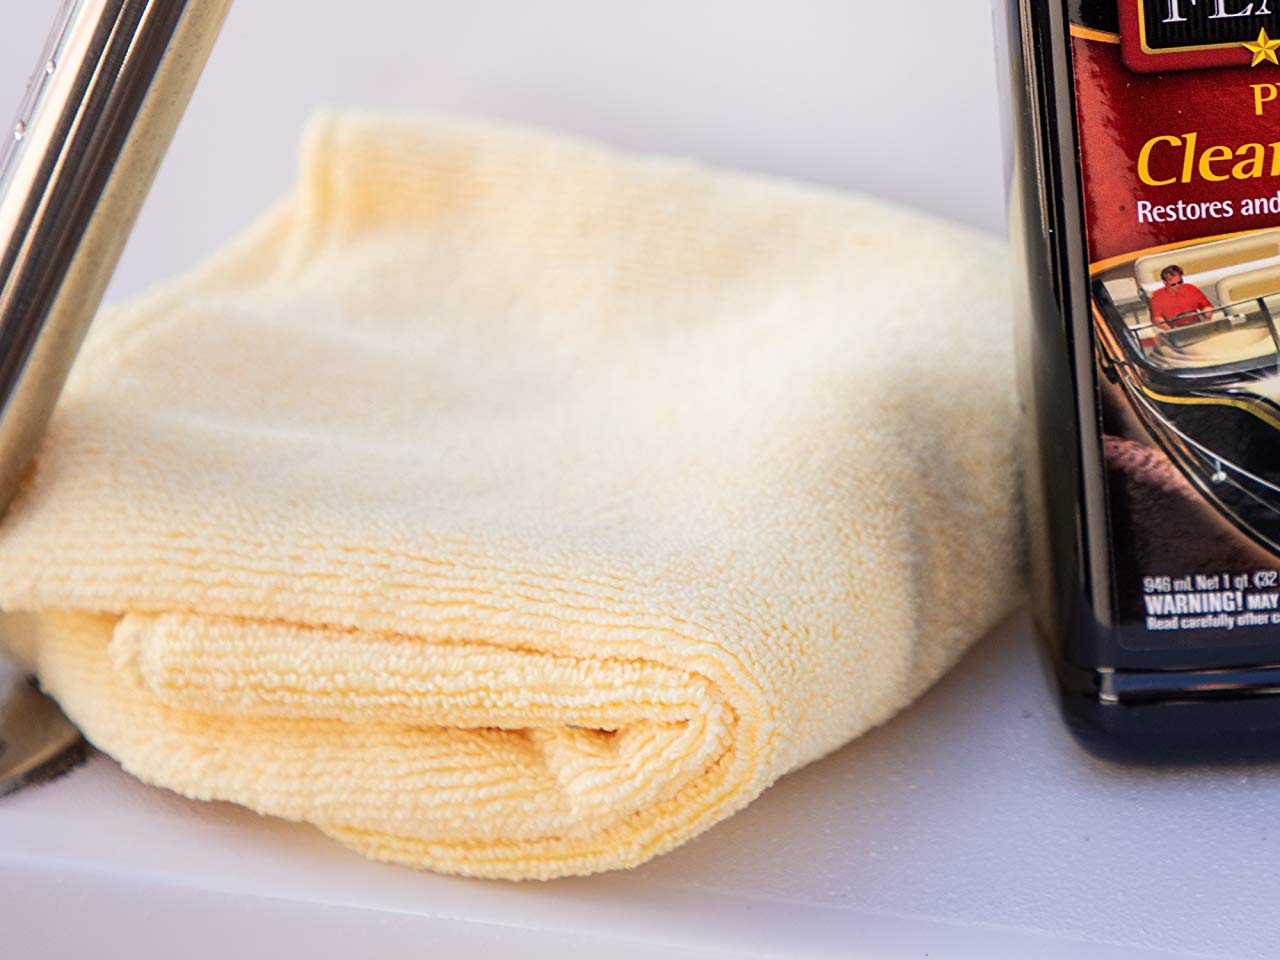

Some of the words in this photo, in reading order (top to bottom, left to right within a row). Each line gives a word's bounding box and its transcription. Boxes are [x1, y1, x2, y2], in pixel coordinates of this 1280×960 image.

[1137, 197, 1233, 223] Restores
[1143, 576, 1171, 592] 946
[1195, 574, 1220, 590] Net
[1222, 573, 1230, 589] 1
[1253, 570, 1278, 589] (32
[1144, 591, 1243, 615] WARNING!
[1247, 593, 1279, 611] MAY
[1146, 616, 1179, 630] Read
[1180, 613, 1235, 630] carefully
[1237, 611, 1269, 626] other
